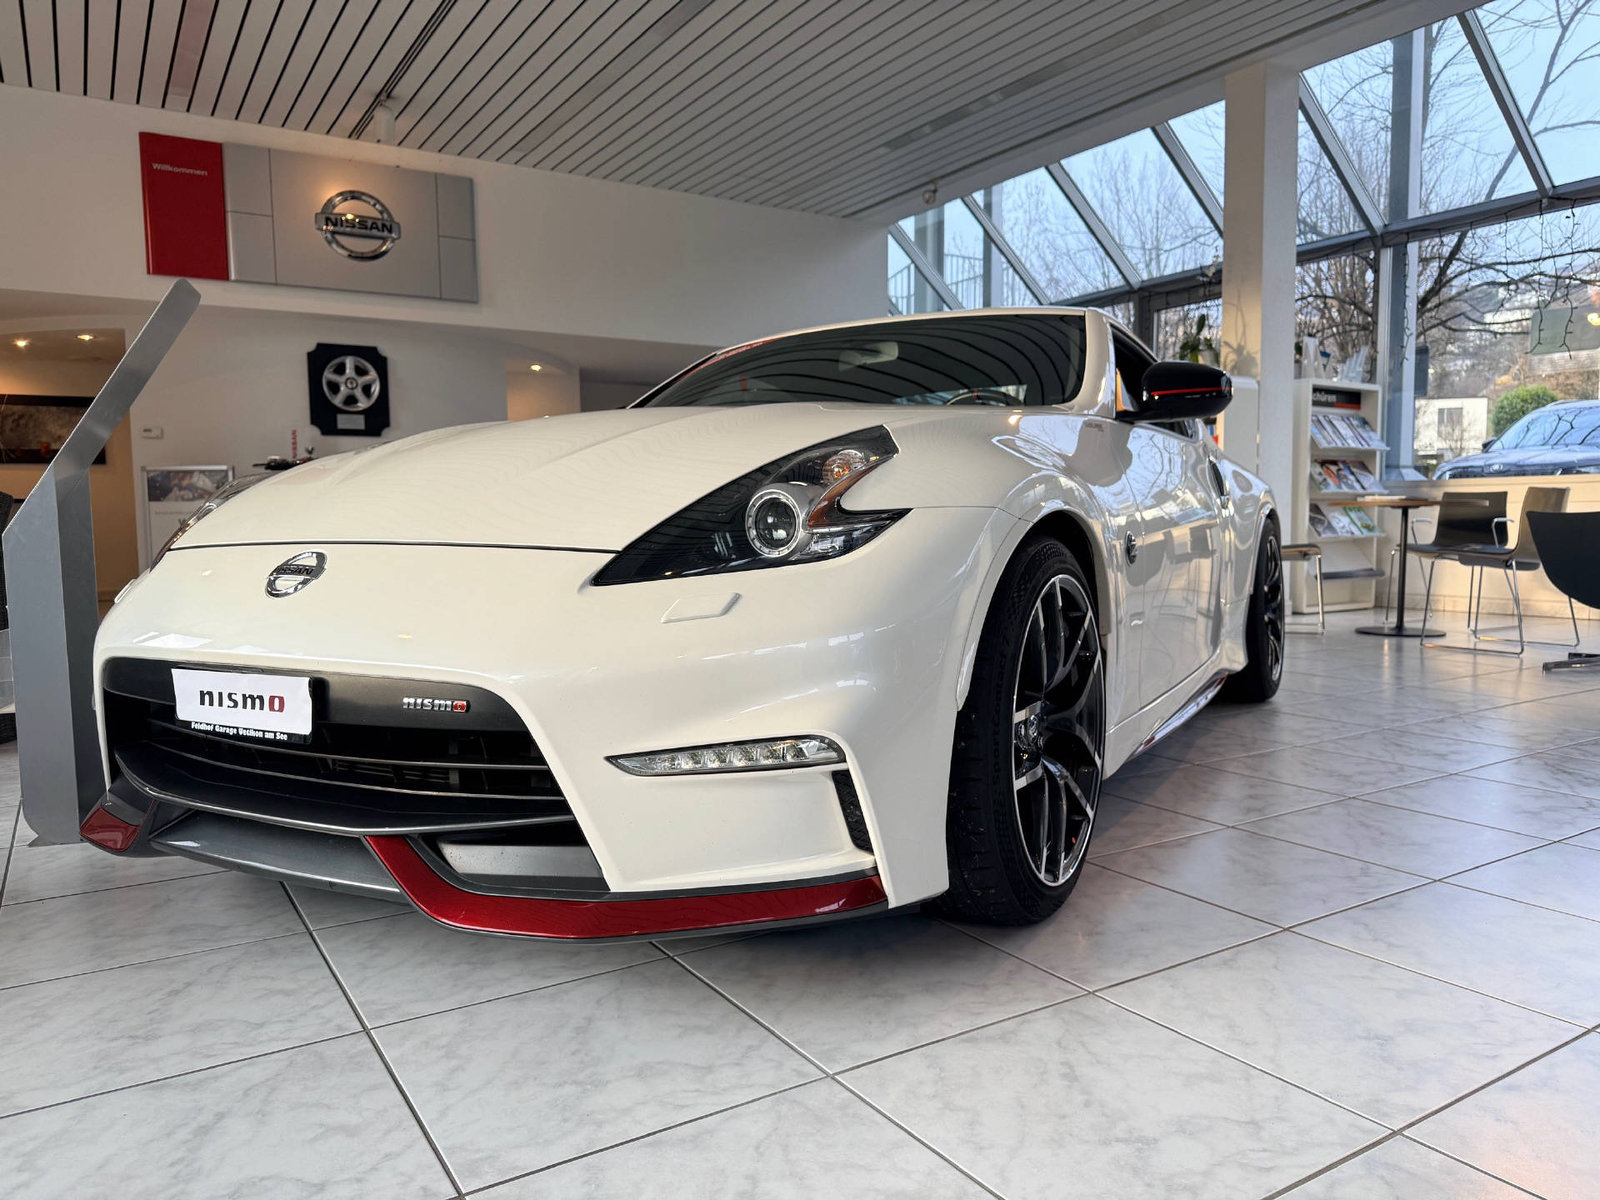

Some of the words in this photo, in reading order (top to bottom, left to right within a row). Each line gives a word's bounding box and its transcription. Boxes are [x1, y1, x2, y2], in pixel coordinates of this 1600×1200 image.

[151, 162, 208, 176] Willkommen
[325, 215, 393, 234] NISSAN
[199, 690, 285, 713] nismo
[402, 697, 467, 712] nismo
[191, 721, 214, 732] Feldhof
[215, 724, 237, 735] Garage
[276, 732, 288, 741] See
